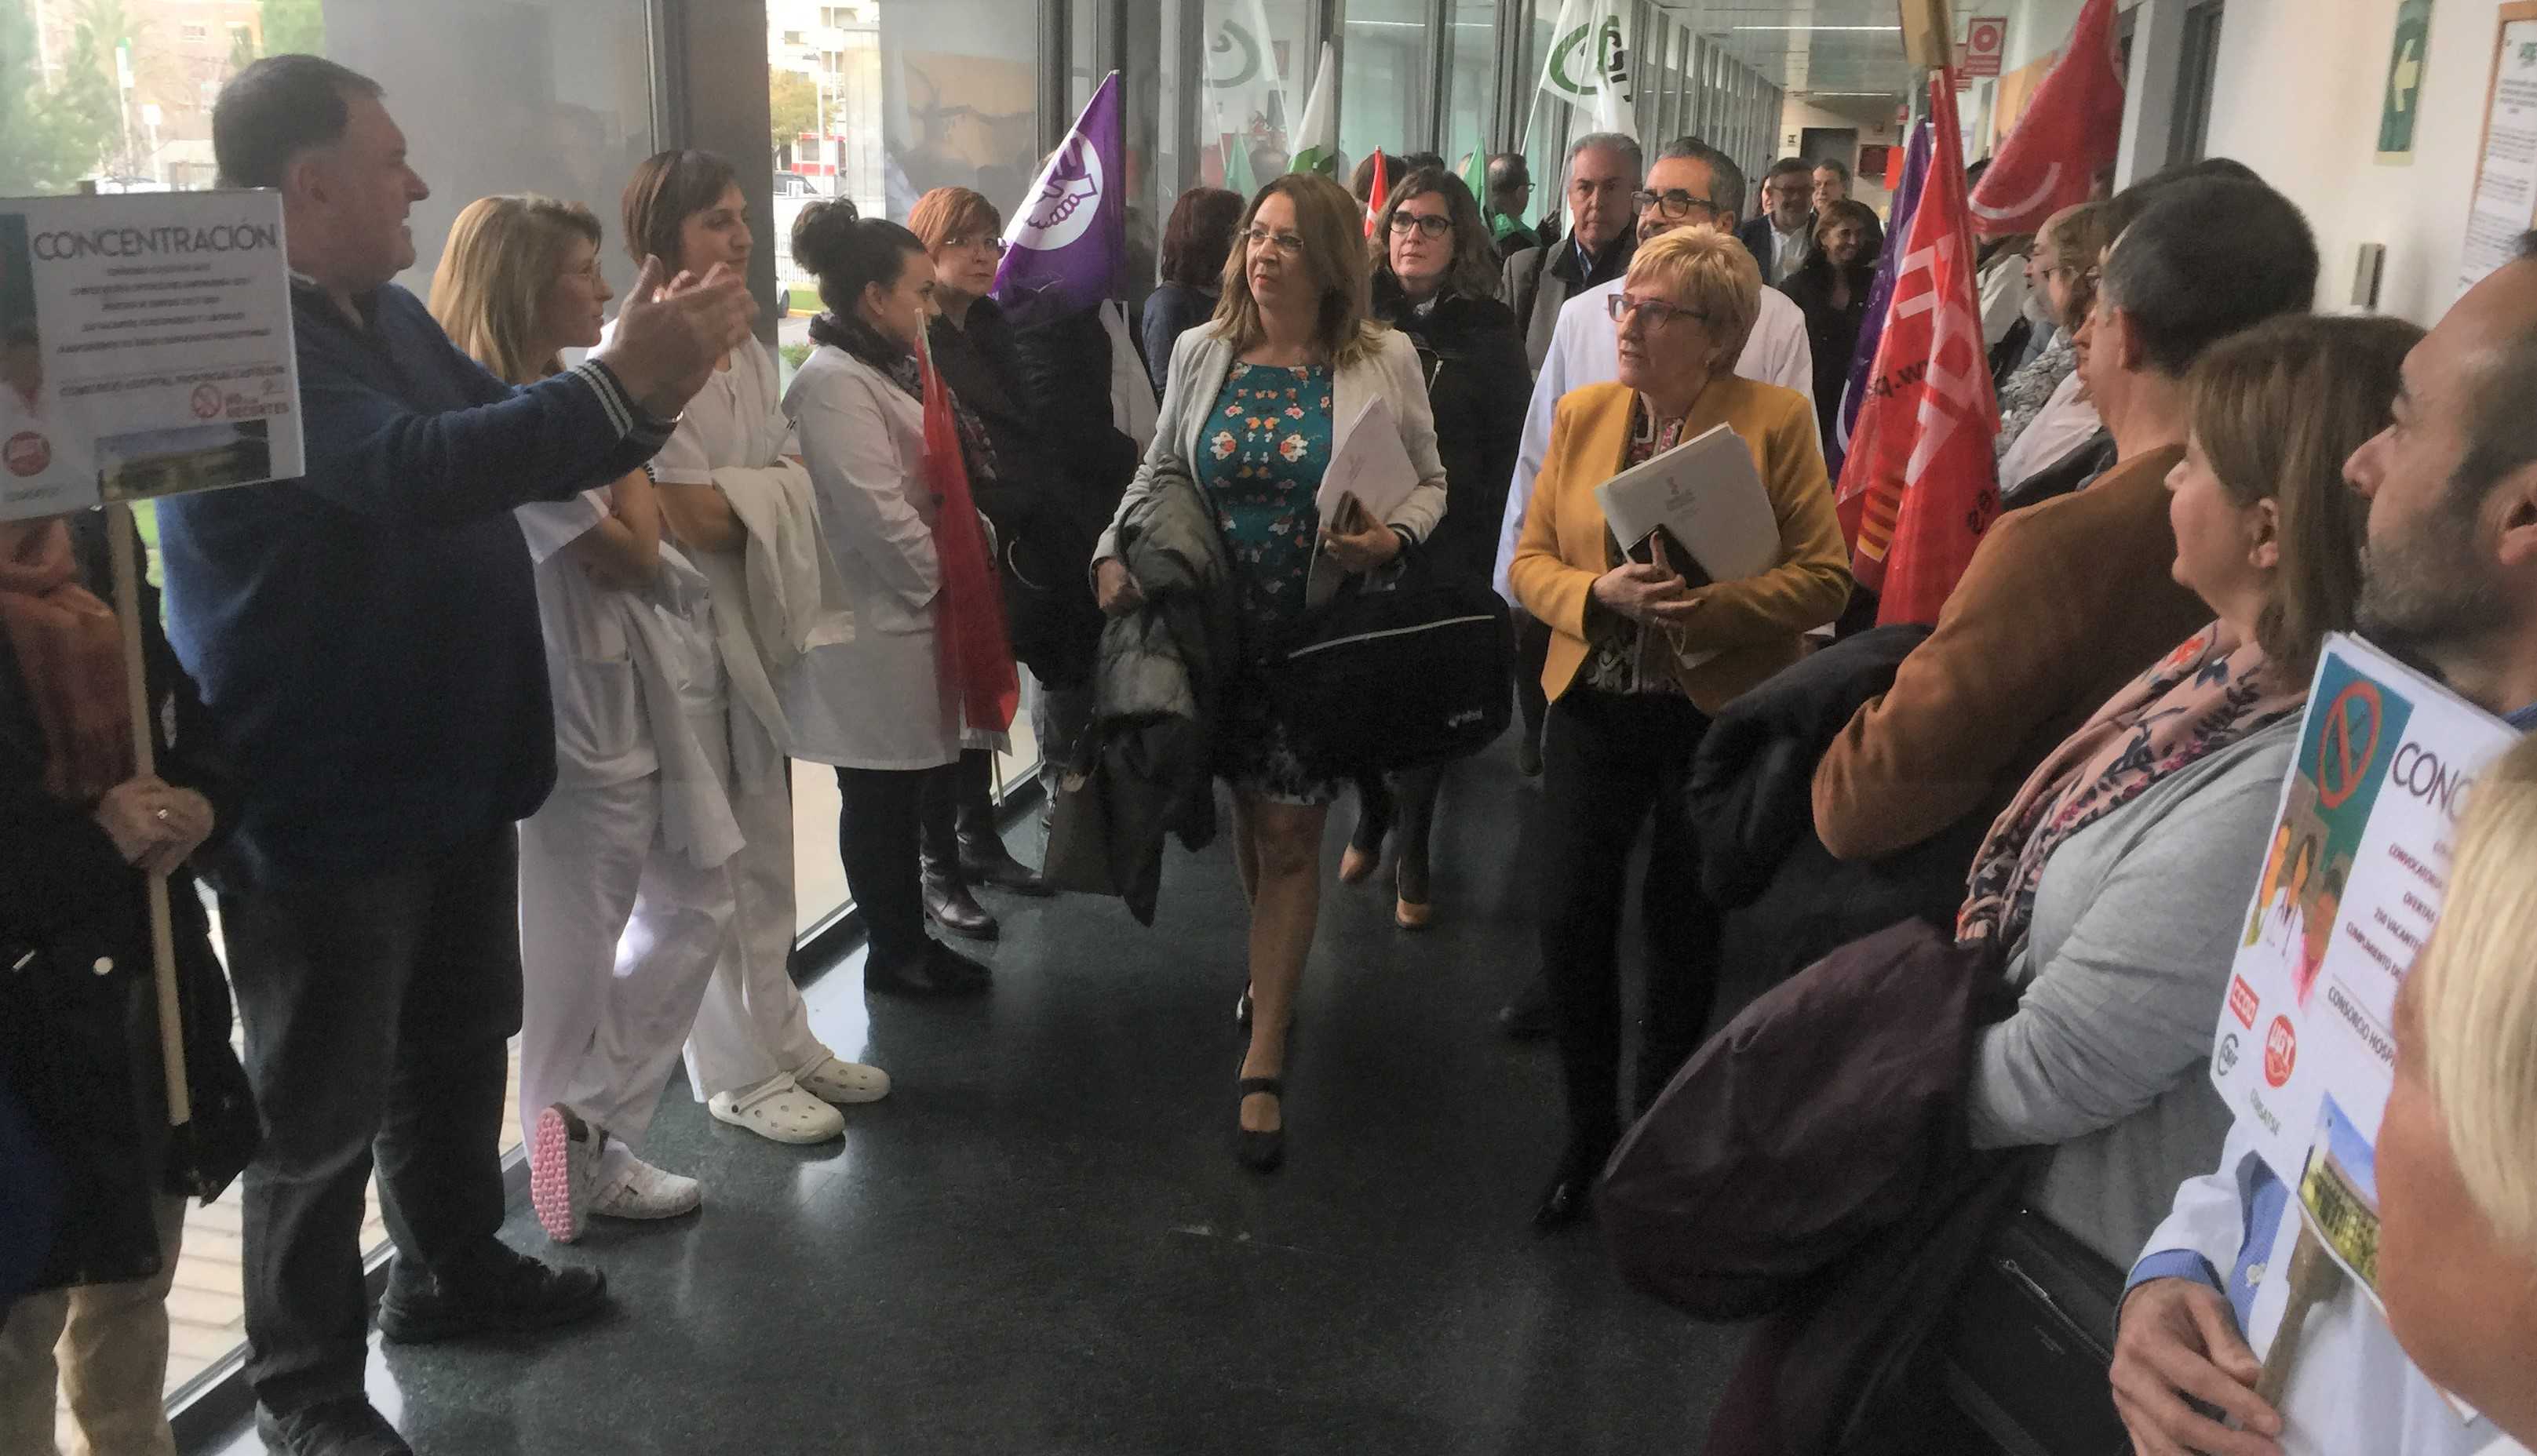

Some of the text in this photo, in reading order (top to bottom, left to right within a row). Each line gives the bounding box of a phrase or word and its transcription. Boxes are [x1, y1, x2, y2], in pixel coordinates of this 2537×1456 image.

[33, 217, 276, 260] CONCENTRACIÓN
[2327, 985, 2370, 1040] CONSORCIO
[2268, 1019, 2294, 1066] UGT
